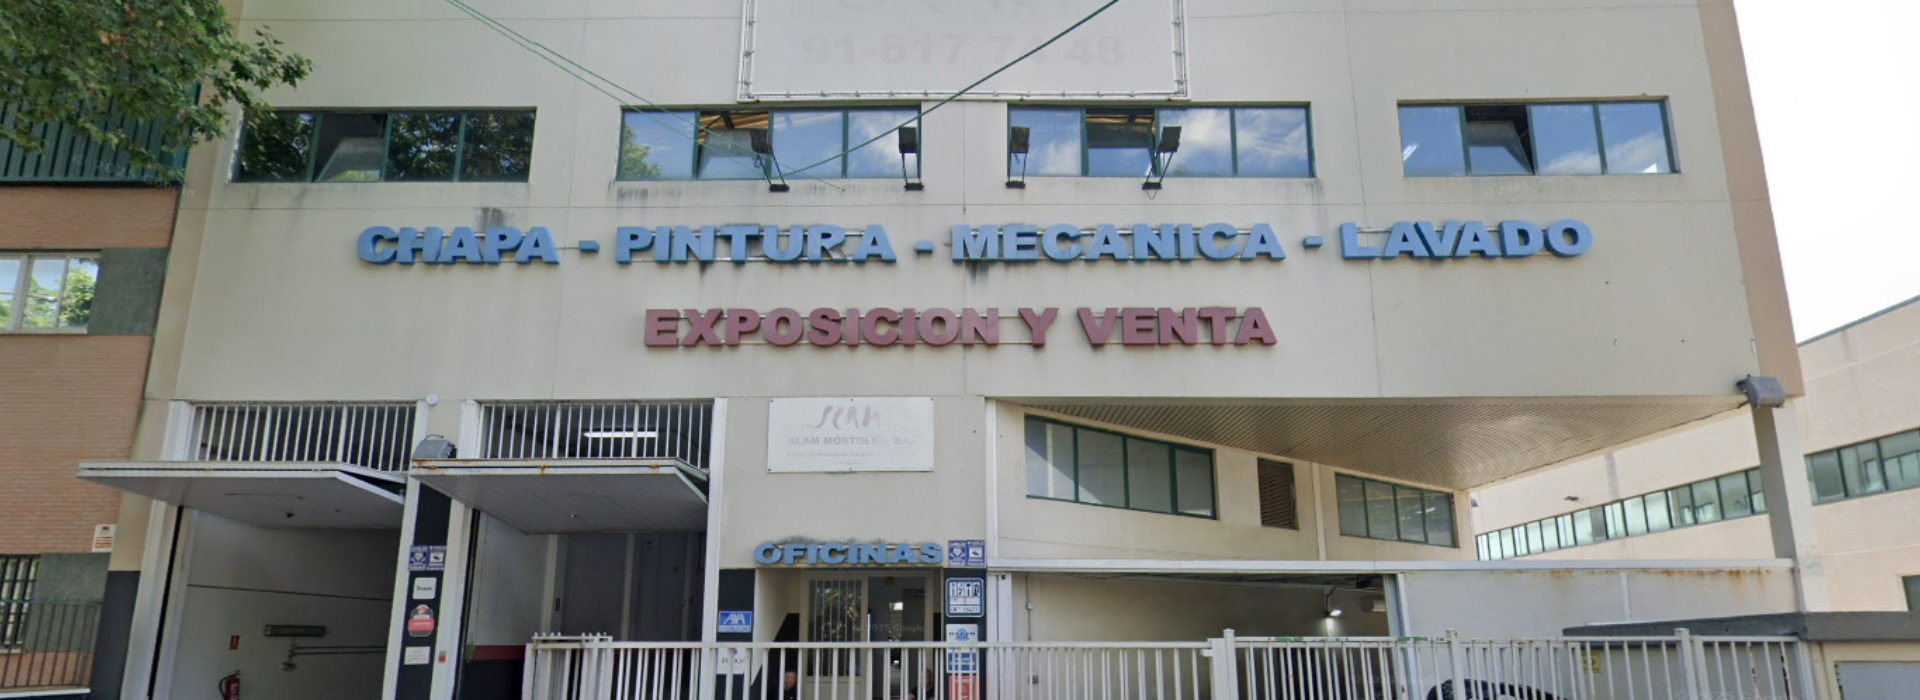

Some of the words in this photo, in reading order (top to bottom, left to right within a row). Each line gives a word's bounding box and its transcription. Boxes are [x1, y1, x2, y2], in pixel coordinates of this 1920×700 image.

[801, 33, 968, 65] 91-617
[1064, 35, 1125, 66] 48
[357, 225, 560, 265] CHAPA
[615, 224, 897, 264] PINTURA
[952, 222, 1287, 263] MECANICA
[1339, 218, 1593, 260] LAVADO
[644, 307, 999, 347] EXPOSICION
[1018, 307, 1060, 348] Y
[1077, 306, 1278, 347] VENTA
[788, 436, 820, 446] SLAM
[823, 434, 882, 446] MÓSTOLE
[753, 541, 946, 566] OFICINAS
[722, 613, 747, 625] AXA
